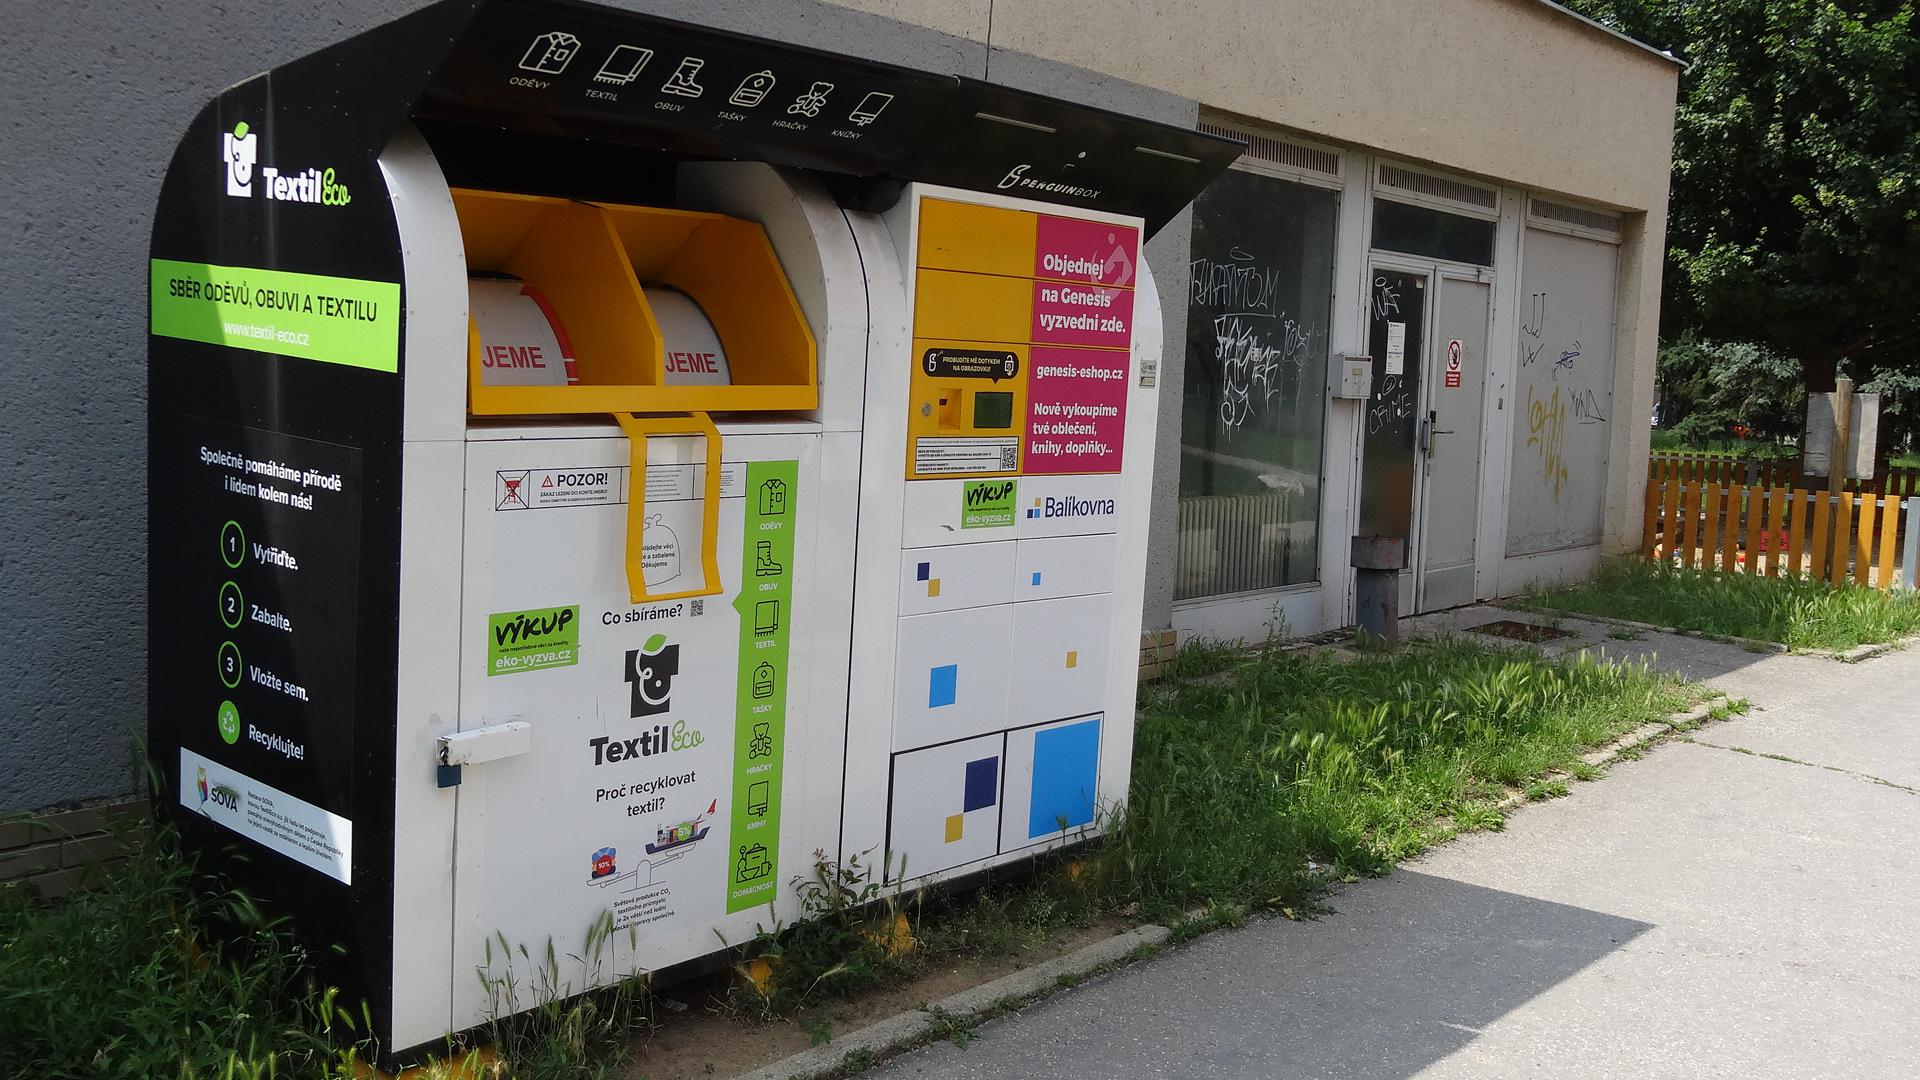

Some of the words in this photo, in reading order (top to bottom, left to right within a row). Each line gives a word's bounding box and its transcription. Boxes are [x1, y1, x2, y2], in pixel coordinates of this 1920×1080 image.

[509, 76, 551, 90] ODĚVY
[585, 89, 618, 102] TEXTIL
[654, 101, 685, 112] OBUV
[717, 111, 748, 122] TAŠKY
[772, 119, 809, 132] HRAČKY
[1043, 254, 1104, 280] Objednej
[169, 276, 201, 300] SBĚR
[204, 281, 253, 309] ODĚVŮ,
[255, 289, 299, 312] OBUVI
[303, 296, 313, 314] A
[317, 295, 377, 322] TEXTILU
[1041, 288, 1058, 303] na
[1061, 287, 1111, 308] Genesis
[1040, 313, 1099, 332] vyzvedni
[1101, 316, 1126, 333] zde.
[223, 322, 309, 346] www.textil-eco.cz
[1036, 363, 1124, 382] genesis-eshop.cz
[1034, 402, 1060, 417] Nově
[1062, 403, 1118, 419] vykoupíme
[1033, 422, 1050, 435] tvé
[1051, 421, 1097, 437] oblečení,
[1031, 441, 1064, 457] knihy,
[200, 446, 243, 469] Společně
[245, 459, 301, 483] pomáháme
[303, 469, 342, 491] přírodě
[557, 473, 608, 487] POZOR!
[224, 475, 228, 490] i
[230, 476, 256, 496] lidem
[258, 483, 289, 504] kolem
[291, 492, 313, 510] nás!
[967, 481, 1013, 506] VÝKUP
[1044, 496, 1115, 518] Balíkovna
[760, 522, 783, 530] ODĚVY
[230, 537, 235, 552] 1
[253, 542, 298, 570] Vytřiďte.
[758, 582, 778, 592] OBUV
[228, 597, 235, 612] 2
[251, 604, 293, 632] Zabalte.
[602, 610, 621, 625] Co
[625, 604, 684, 622] sbíráme?
[495, 608, 573, 646] VÝKUP
[755, 640, 777, 649] TEXTIL
[226, 657, 234, 672] 3
[495, 650, 571, 668] eko-vyzva.cz
[250, 665, 282, 691] Vložte
[284, 681, 309, 701] sem.
[752, 704, 772, 714] TAŠKY
[249, 723, 304, 760] Recyklujte!
[746, 764, 772, 775] HRAČKY
[596, 784, 626, 802] Proč
[630, 771, 696, 795] recyklovat
[210, 787, 238, 813] SOVA
[627, 797, 666, 817] textil?
[746, 819, 767, 831] KNIHY
[613, 896, 634, 907] Světová
[635, 890, 659, 903] produkce
